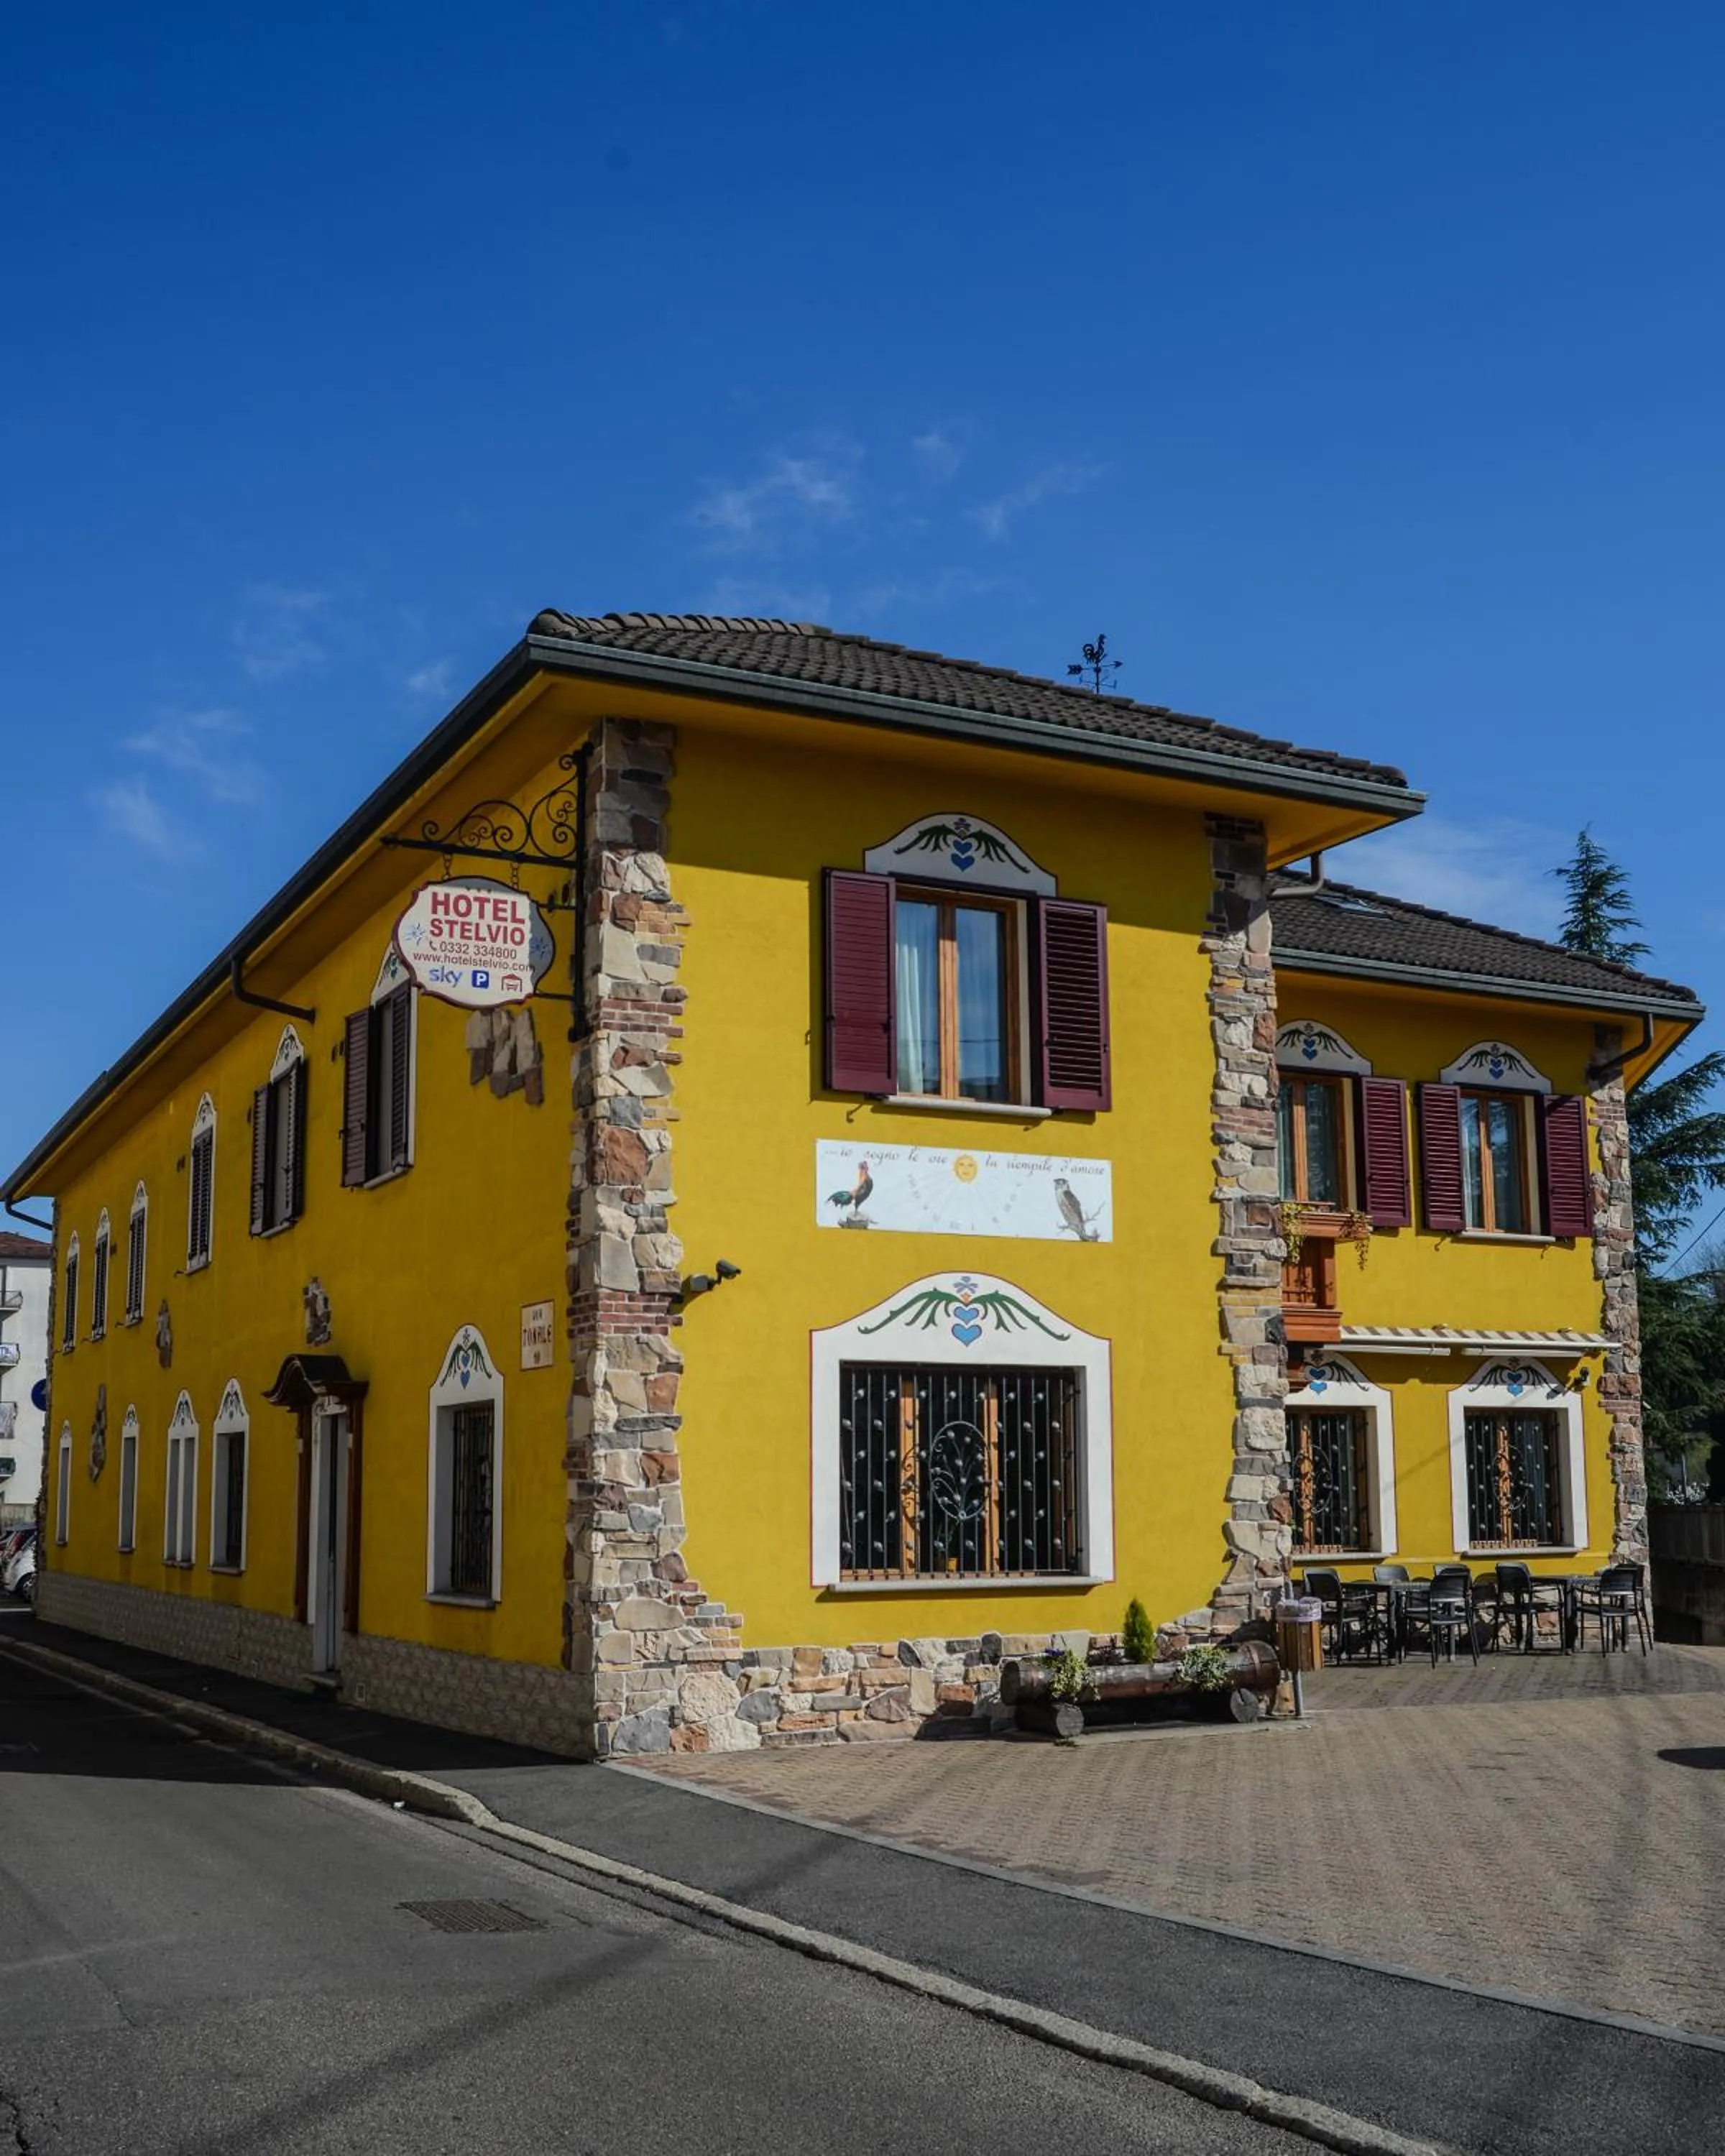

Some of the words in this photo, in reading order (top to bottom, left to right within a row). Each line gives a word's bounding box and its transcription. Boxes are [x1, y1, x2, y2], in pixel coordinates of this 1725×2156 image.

[431, 892, 525, 925] HOTEL
[430, 918, 525, 946] STELVIO
[439, 941, 469, 955] 0332
[474, 945, 517, 959] 334800
[413, 952, 535, 973] www.hotelstelvio.com
[429, 965, 463, 987] sky
